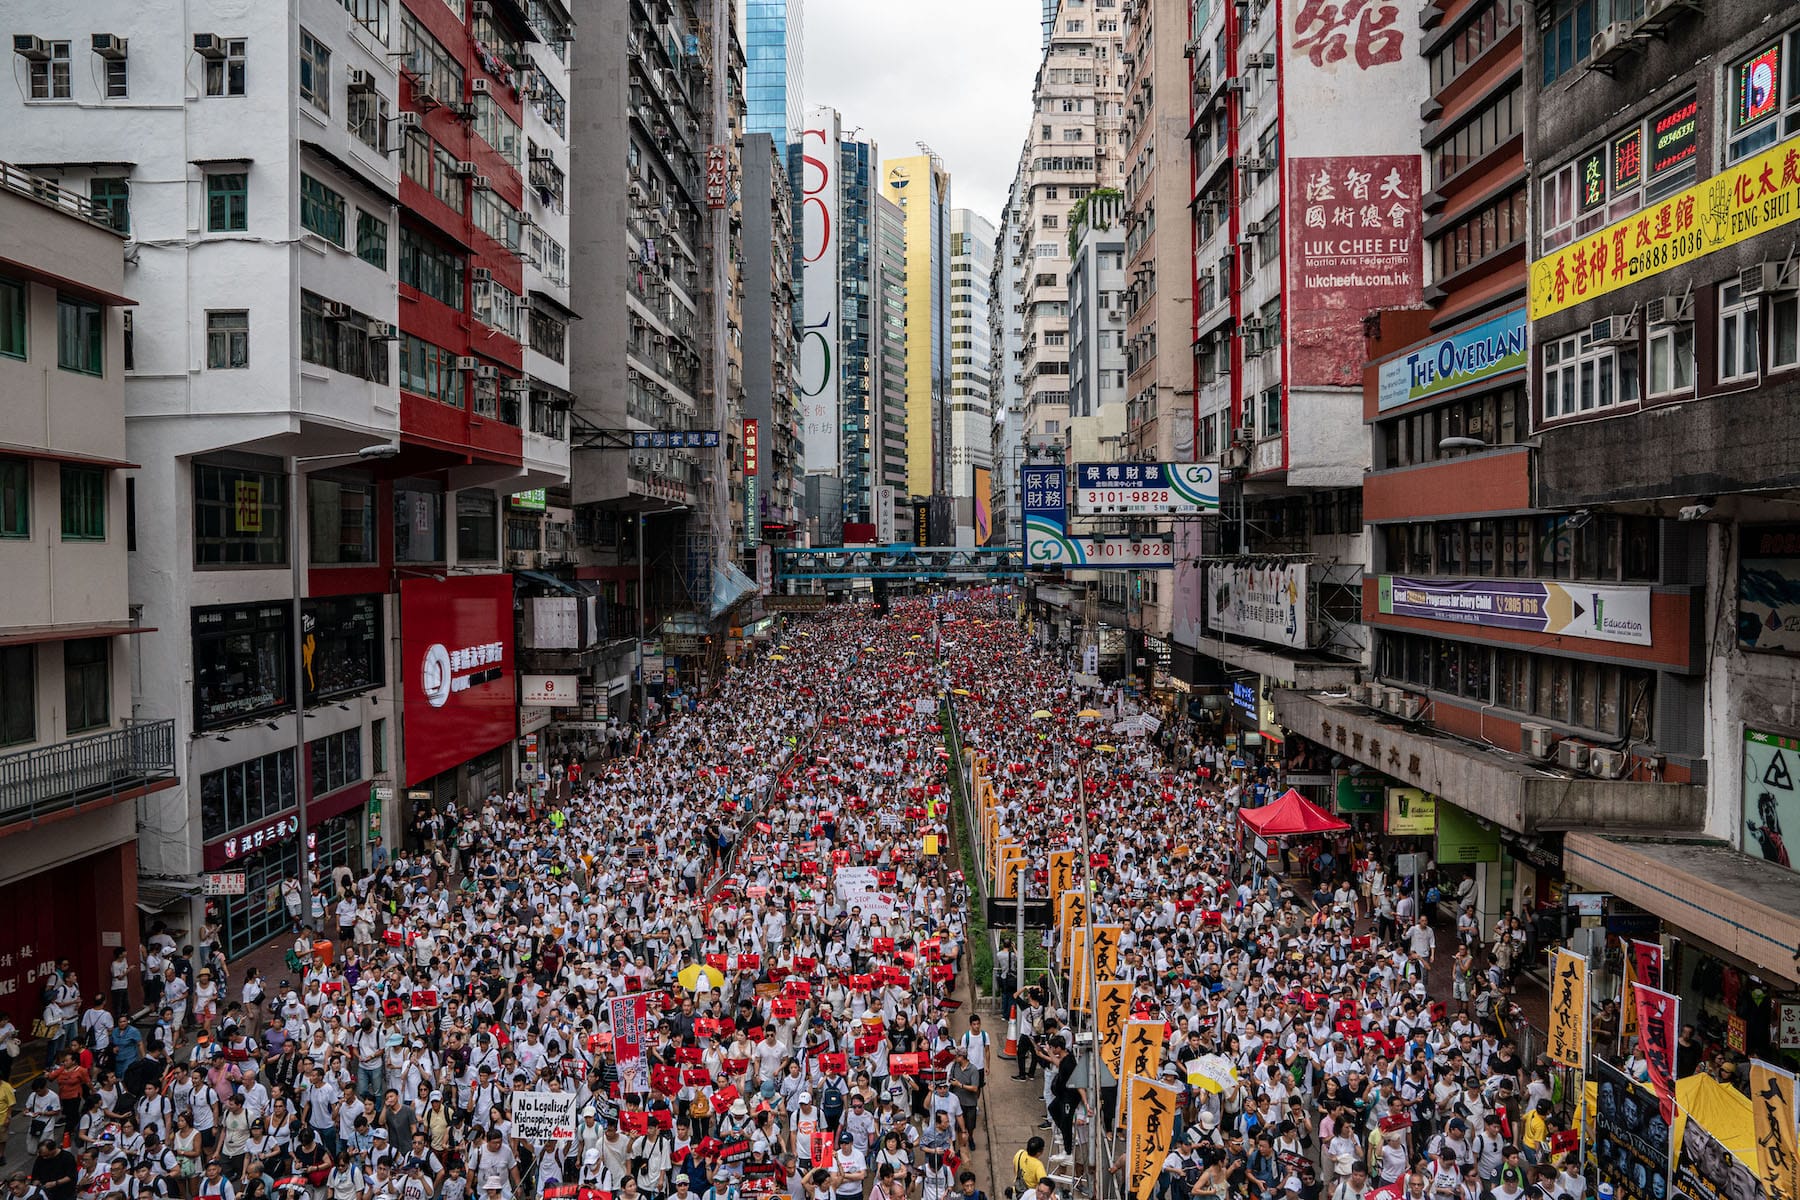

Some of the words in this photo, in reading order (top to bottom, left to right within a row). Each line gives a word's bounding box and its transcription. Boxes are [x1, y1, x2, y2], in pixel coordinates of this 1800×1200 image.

[1618, 142, 1639, 180] 港
[1306, 167, 1410, 202] 陸智夫
[1586, 156, 1600, 205] 改名
[1305, 202, 1411, 229] 國術總會
[1731, 210, 1758, 235] FENG
[1763, 192, 1790, 222] SHUI
[1304, 240, 1334, 256] LUK
[1339, 239, 1383, 253] CHEE
[1389, 238, 1409, 252] FU
[1553, 226, 1628, 304] 香港神算
[1635, 195, 1695, 248] 改運館
[1639, 243, 1668, 274] 6888
[1672, 230, 1702, 260] 5036
[1305, 257, 1337, 267] Martial
[1340, 256, 1357, 265] Arts
[1359, 254, 1409, 265] Federation
[1305, 271, 1410, 288] lukcheefu.com.hk
[1407, 353, 1435, 388] THE
[746, 425, 755, 470] 六福珠寶
[1027, 474, 1060, 489] 保得
[1087, 466, 1159, 480] 保得財務
[1027, 492, 1060, 506] 財務
[1089, 491, 1168, 502] 3101-9828
[1086, 544, 1170, 556] 3101-9828
[1426, 592, 1450, 606] Programs
[1460, 595, 1475, 609] Every
[1476, 597, 1492, 610] Child
[1523, 599, 1538, 614] 1616
[1604, 618, 1641, 630] Education
[519, 1099, 532, 1111] No
[534, 1099, 569, 1113] Legalised
[514, 1112, 553, 1127] Kidnapping
[552, 1125, 573, 1138] China
